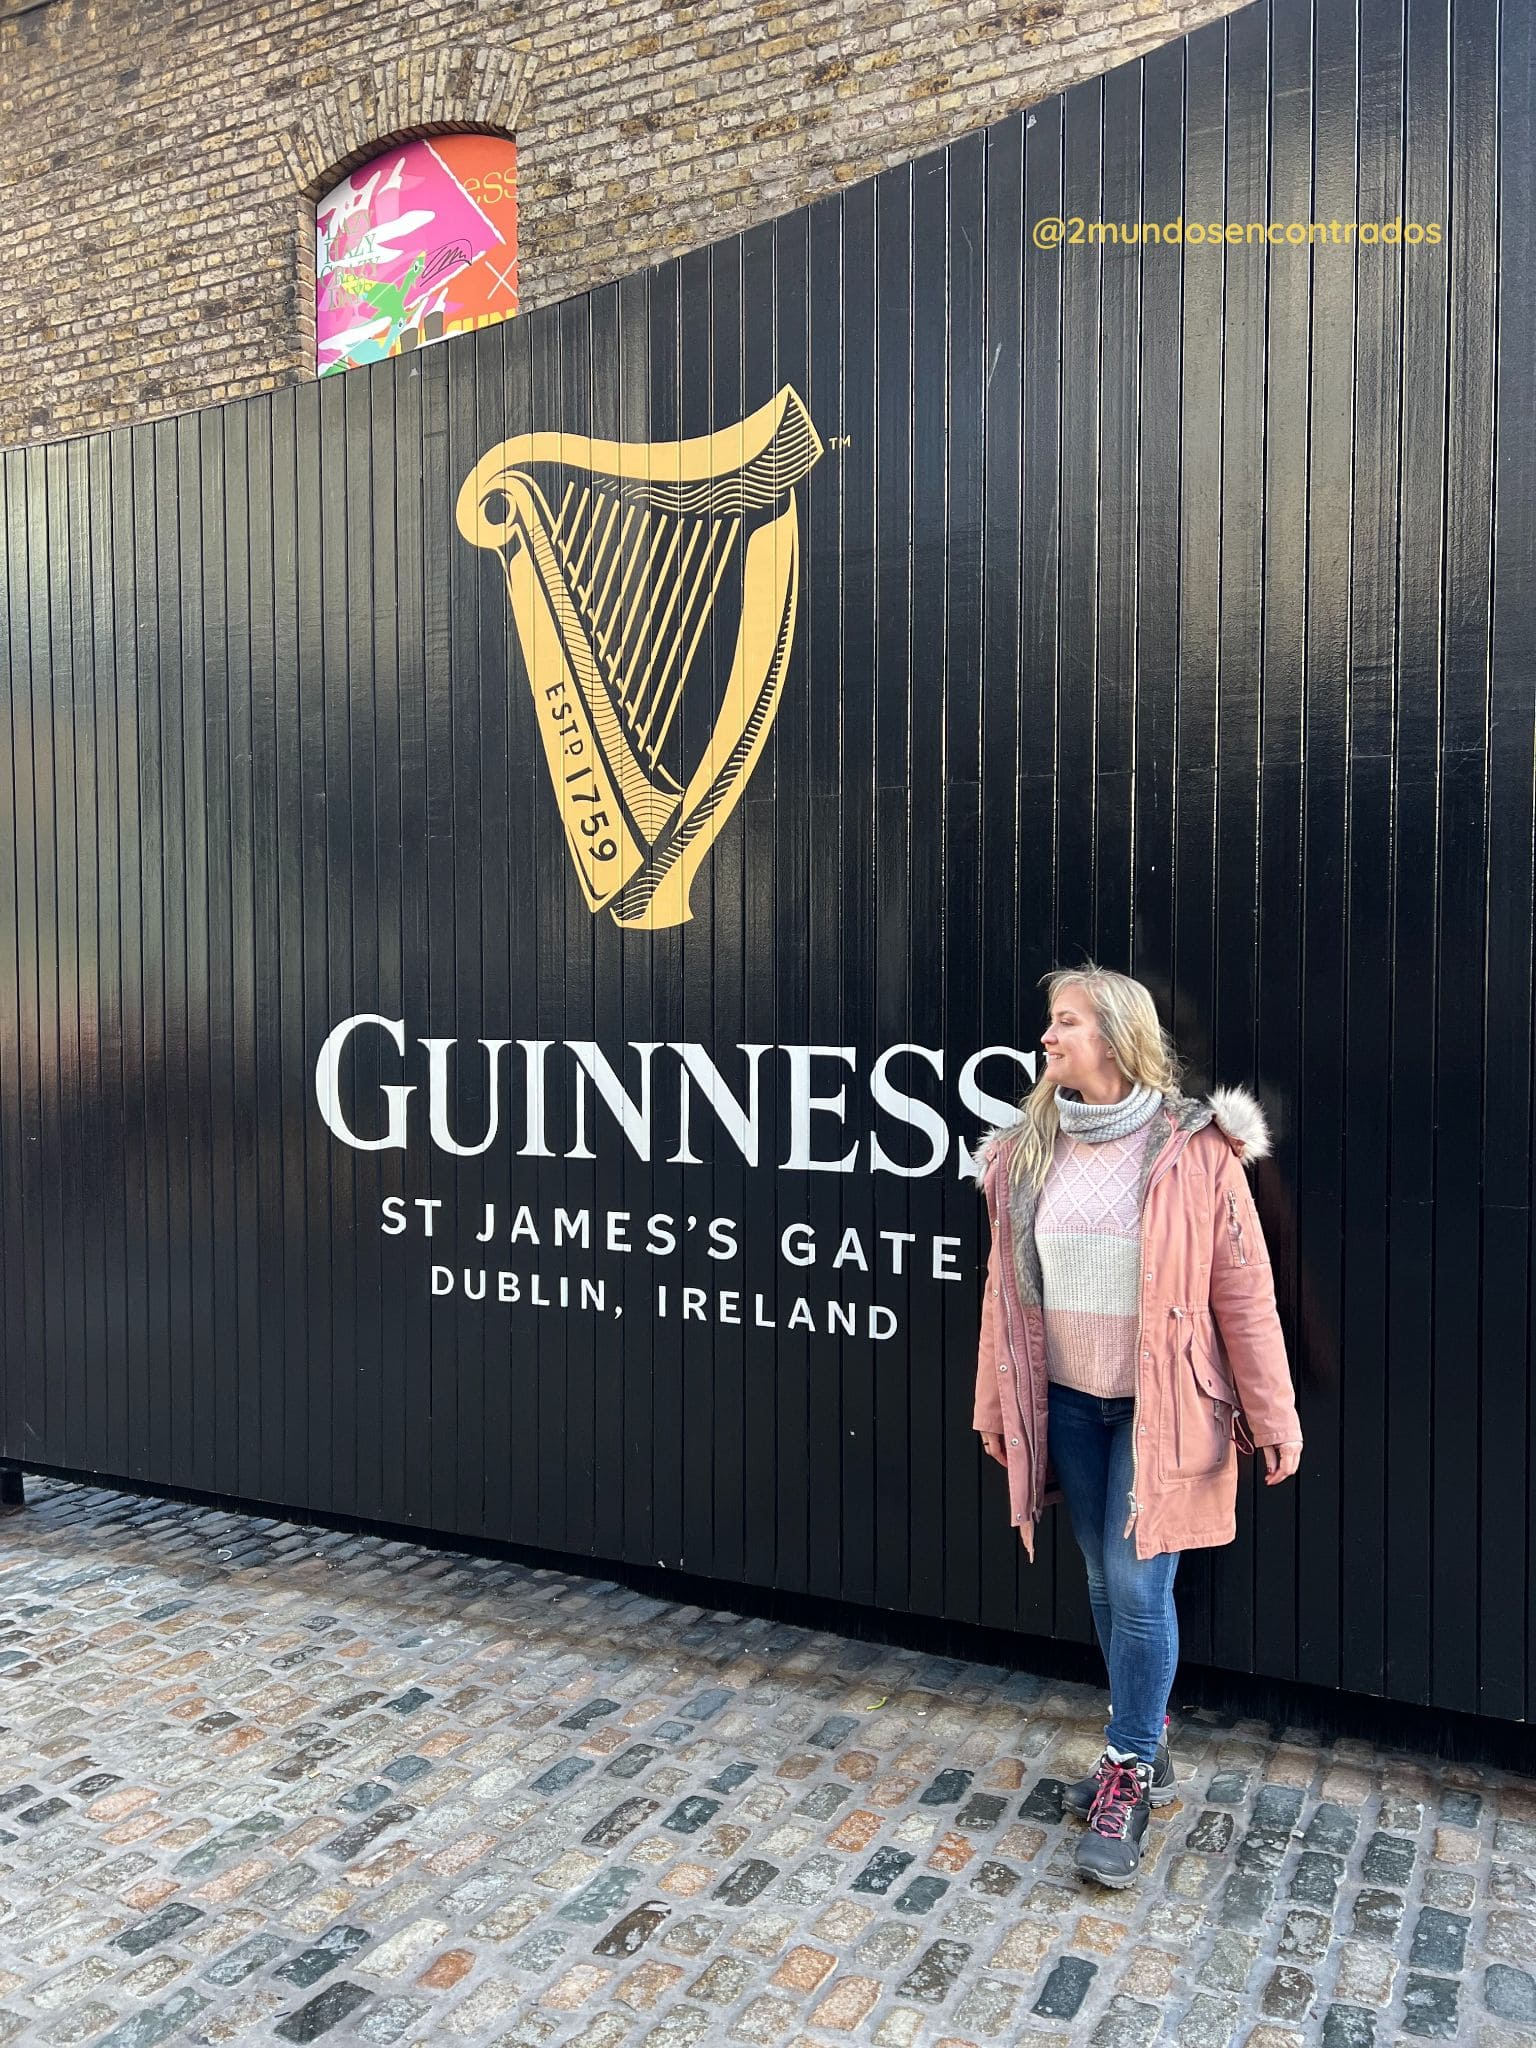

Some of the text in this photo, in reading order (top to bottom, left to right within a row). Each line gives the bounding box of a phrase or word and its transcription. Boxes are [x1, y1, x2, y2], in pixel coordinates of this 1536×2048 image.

[828, 434, 851, 450] TM
[565, 766, 618, 862] 1759
[315, 1013, 1038, 1181] GUINNESS
[380, 1197, 963, 1282] ST JAMES’S GATE
[431, 1265, 899, 1340] DUBLIN, IRELAND
